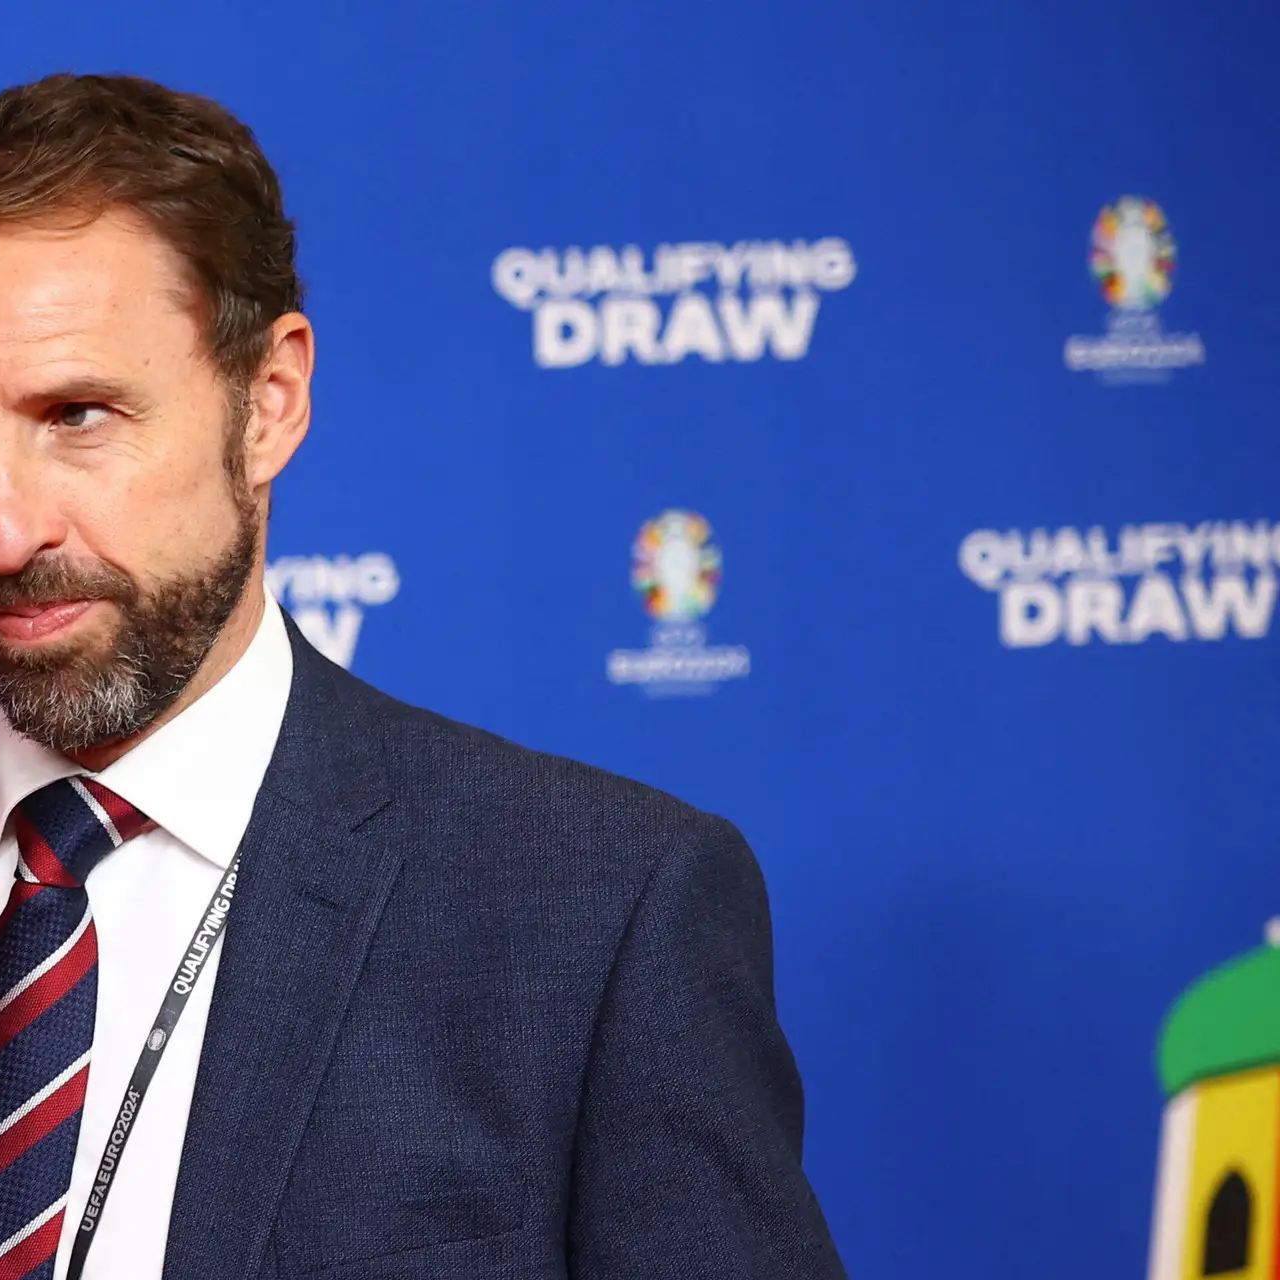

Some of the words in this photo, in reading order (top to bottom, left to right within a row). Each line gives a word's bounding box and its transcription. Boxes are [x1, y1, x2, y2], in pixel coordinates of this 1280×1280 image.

[493, 239, 856, 308] QUALIFYING
[532, 293, 822, 368] DRAW
[959, 521, 1280, 591] QUALIFYIN
[998, 572, 1278, 647] DRAW
[173, 897, 231, 995] QUALIFYING
